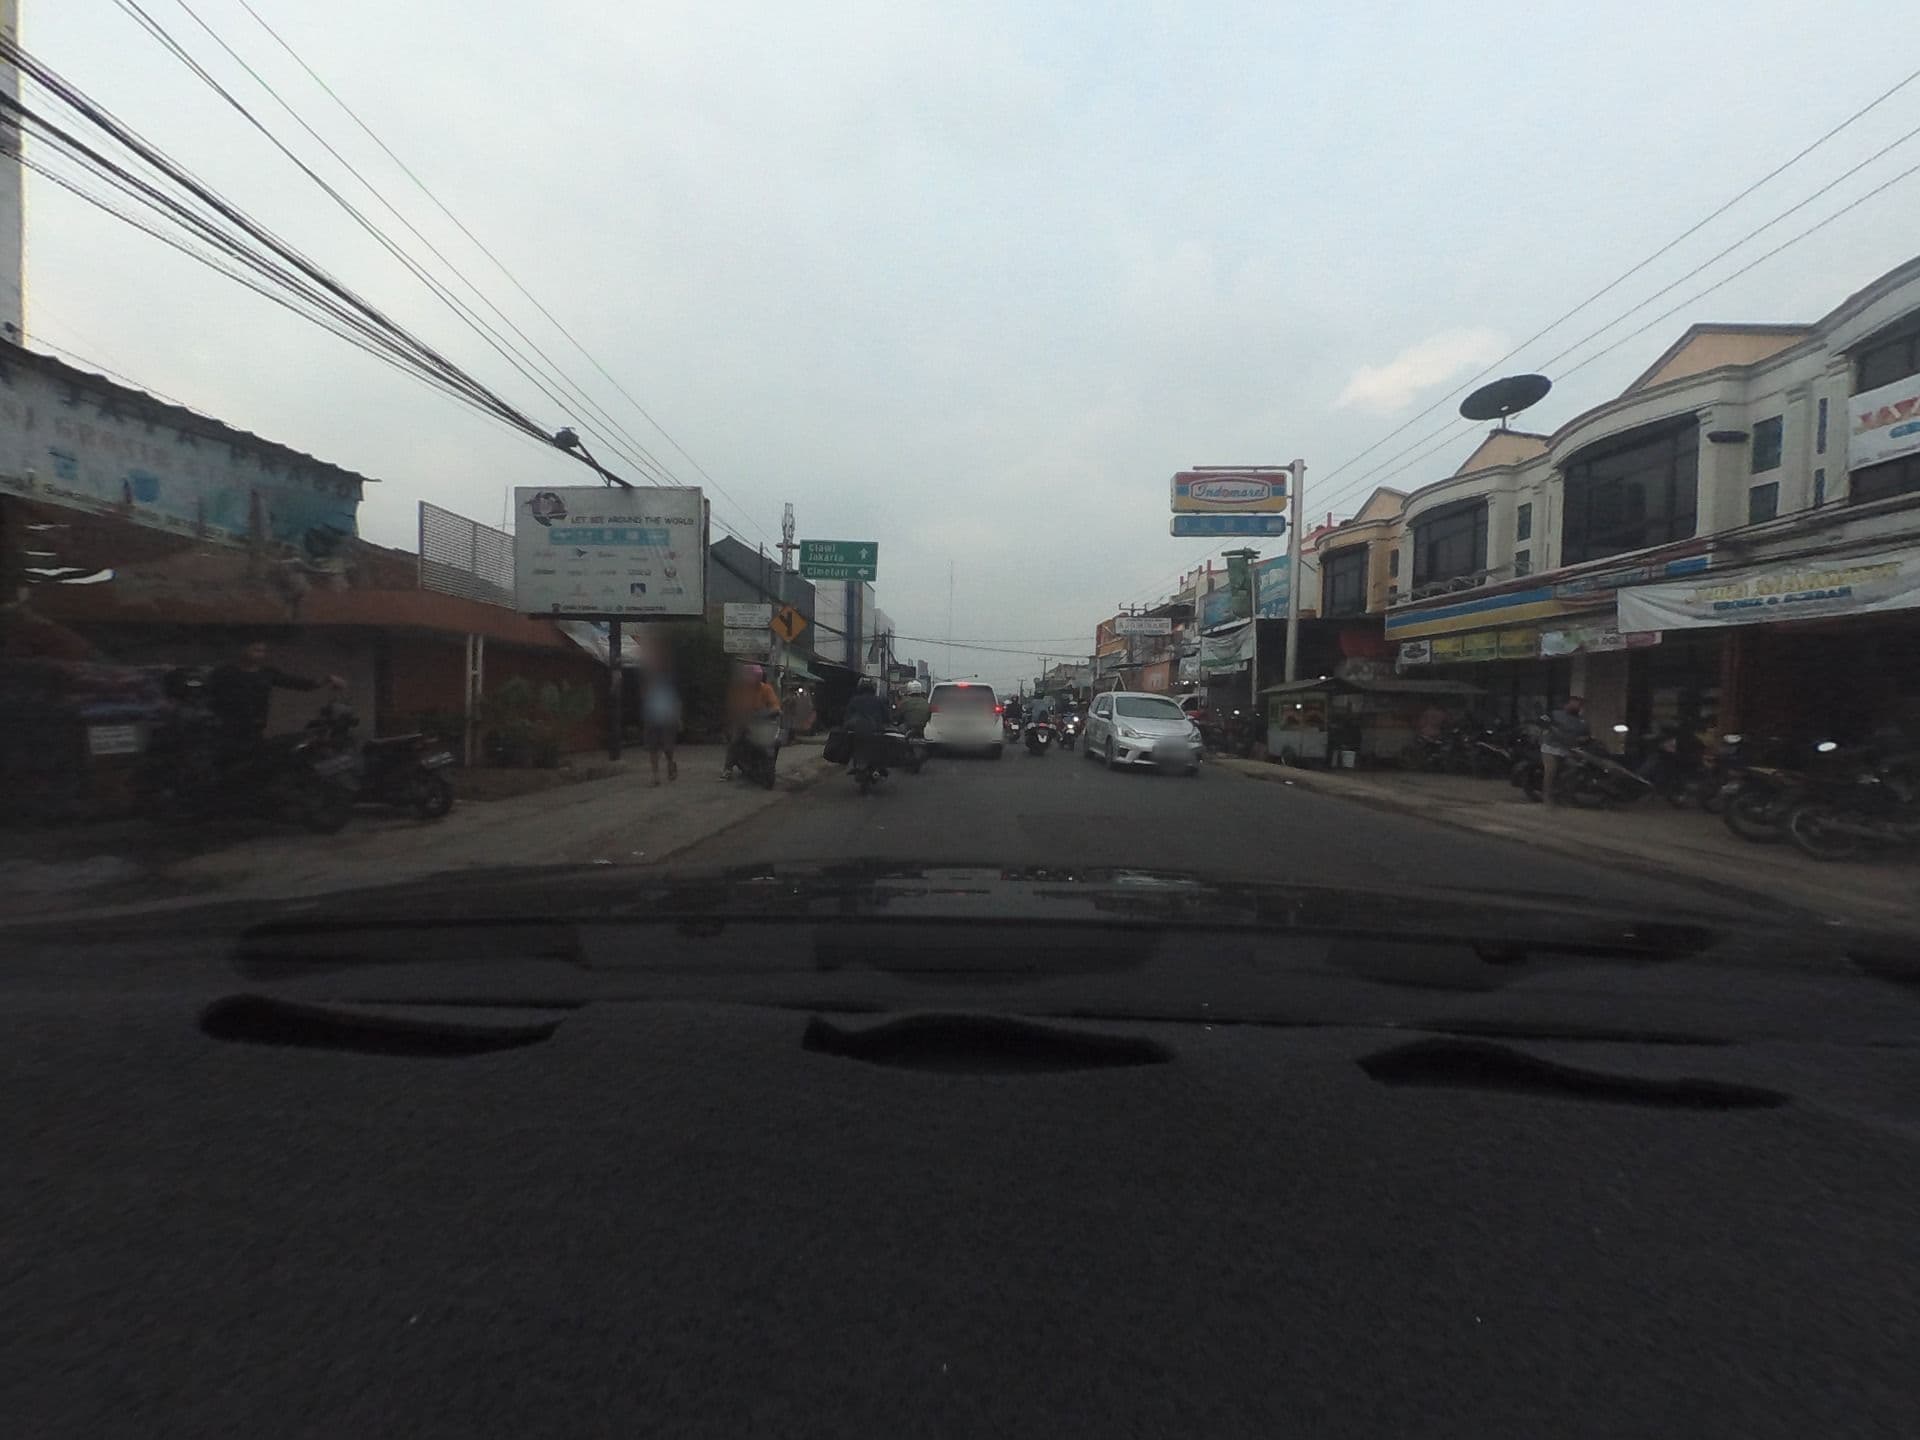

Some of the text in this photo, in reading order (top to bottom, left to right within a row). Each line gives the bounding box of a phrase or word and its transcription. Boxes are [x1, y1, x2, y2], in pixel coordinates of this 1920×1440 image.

[1195, 485, 1265, 498] Indomaret
[608, 516, 641, 524] AROUND
[645, 516, 660, 524] THE
[665, 516, 694, 526] WORLD
[808, 543, 836, 552] Ciawi
[808, 552, 844, 561] Jakarta
